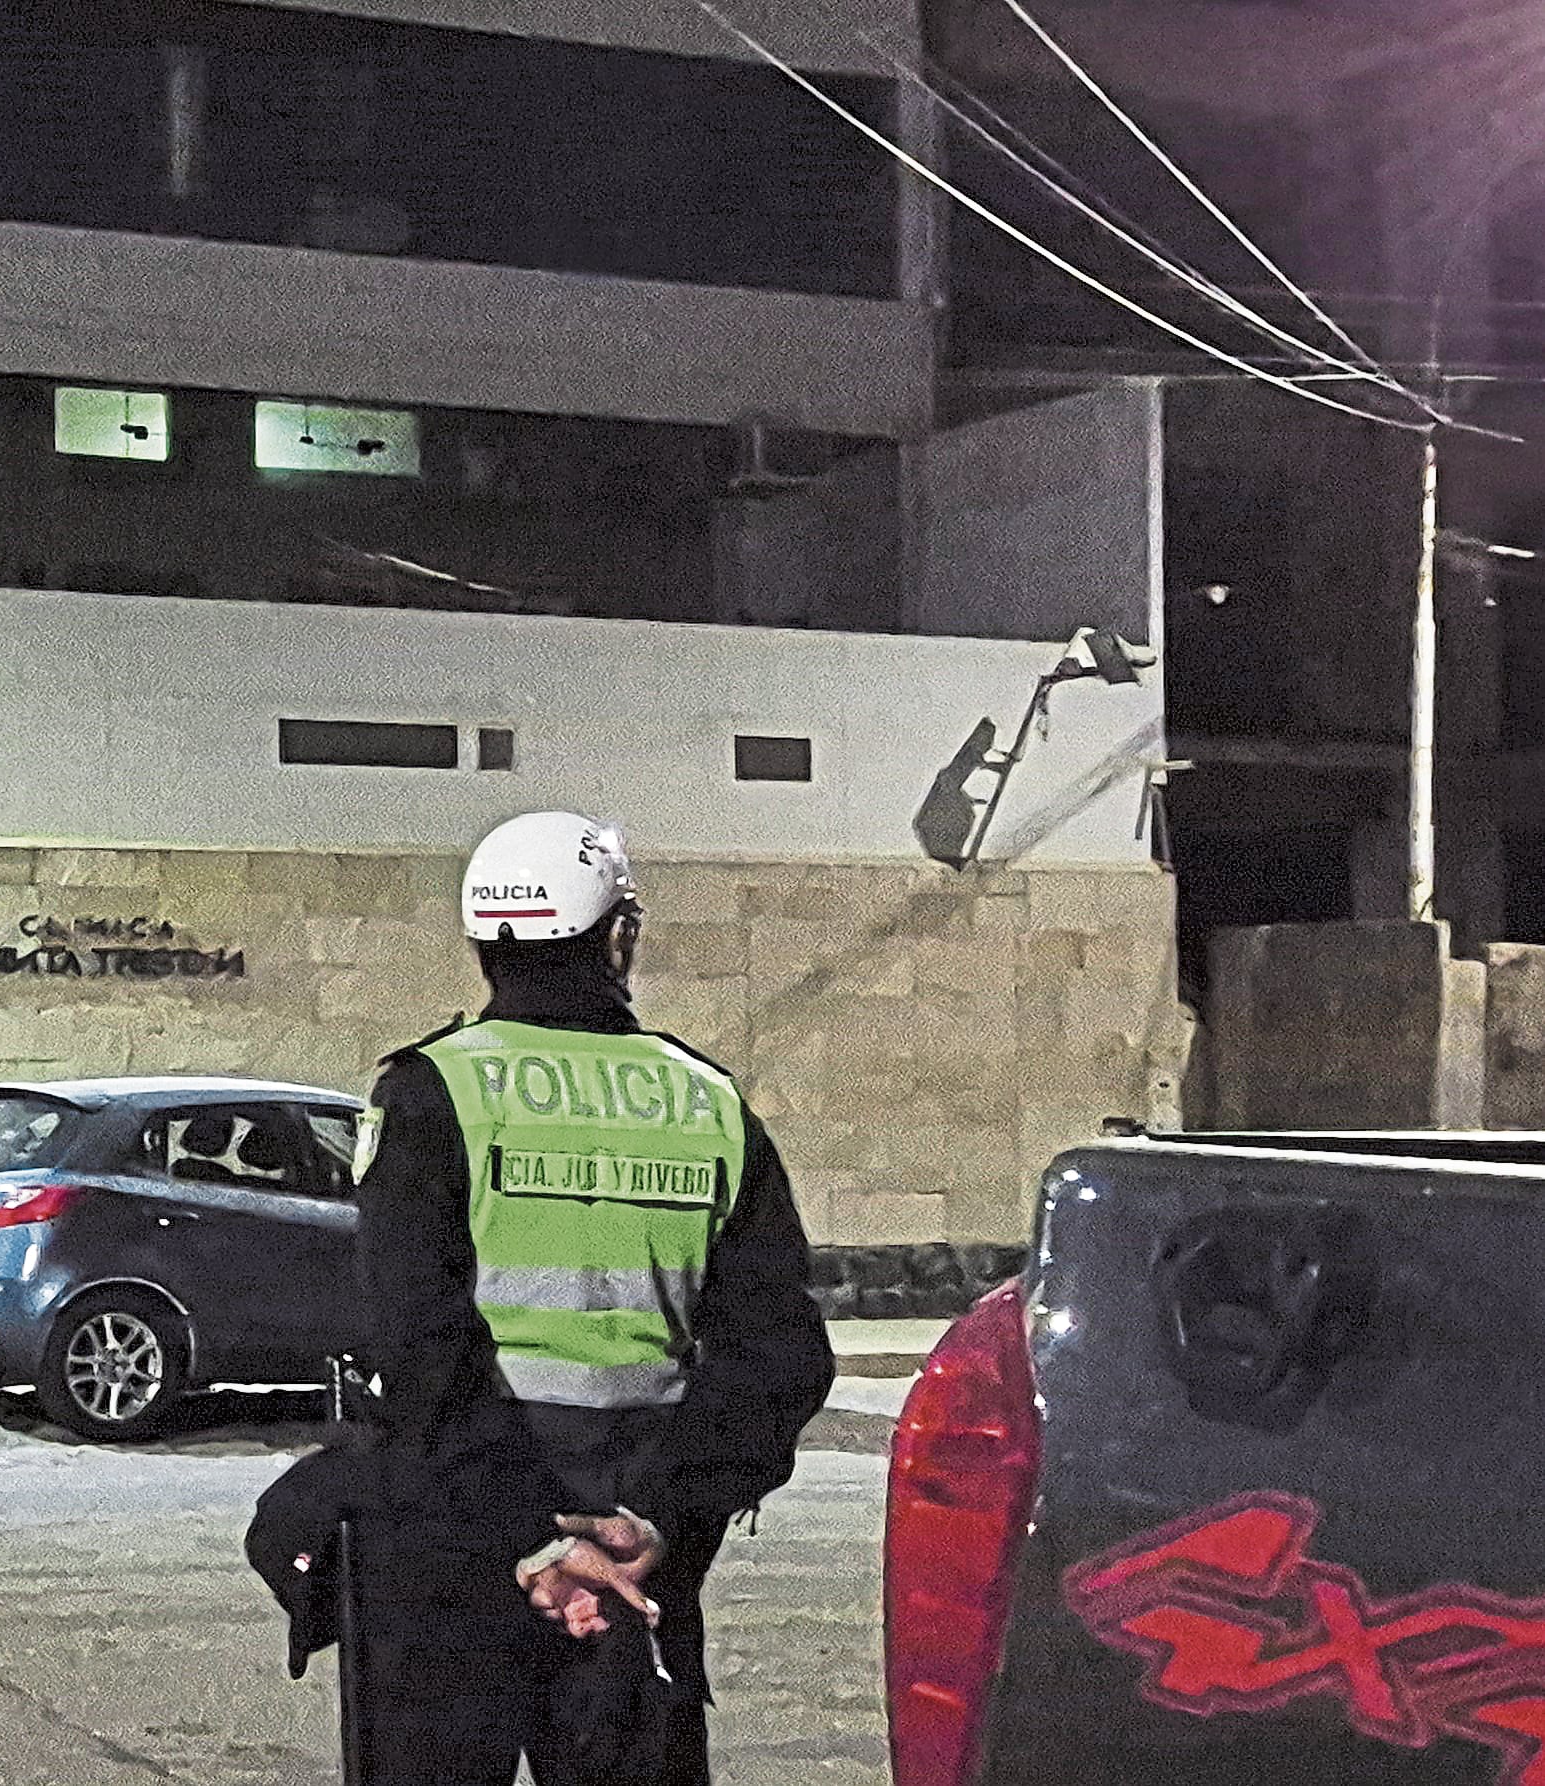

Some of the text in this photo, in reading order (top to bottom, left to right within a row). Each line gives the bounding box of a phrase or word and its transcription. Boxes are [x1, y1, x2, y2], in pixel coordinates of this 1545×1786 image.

[471, 884, 548, 900] POLICIA
[471, 1055, 729, 1138] POLICIA
[613, 1159, 627, 1191] Y
